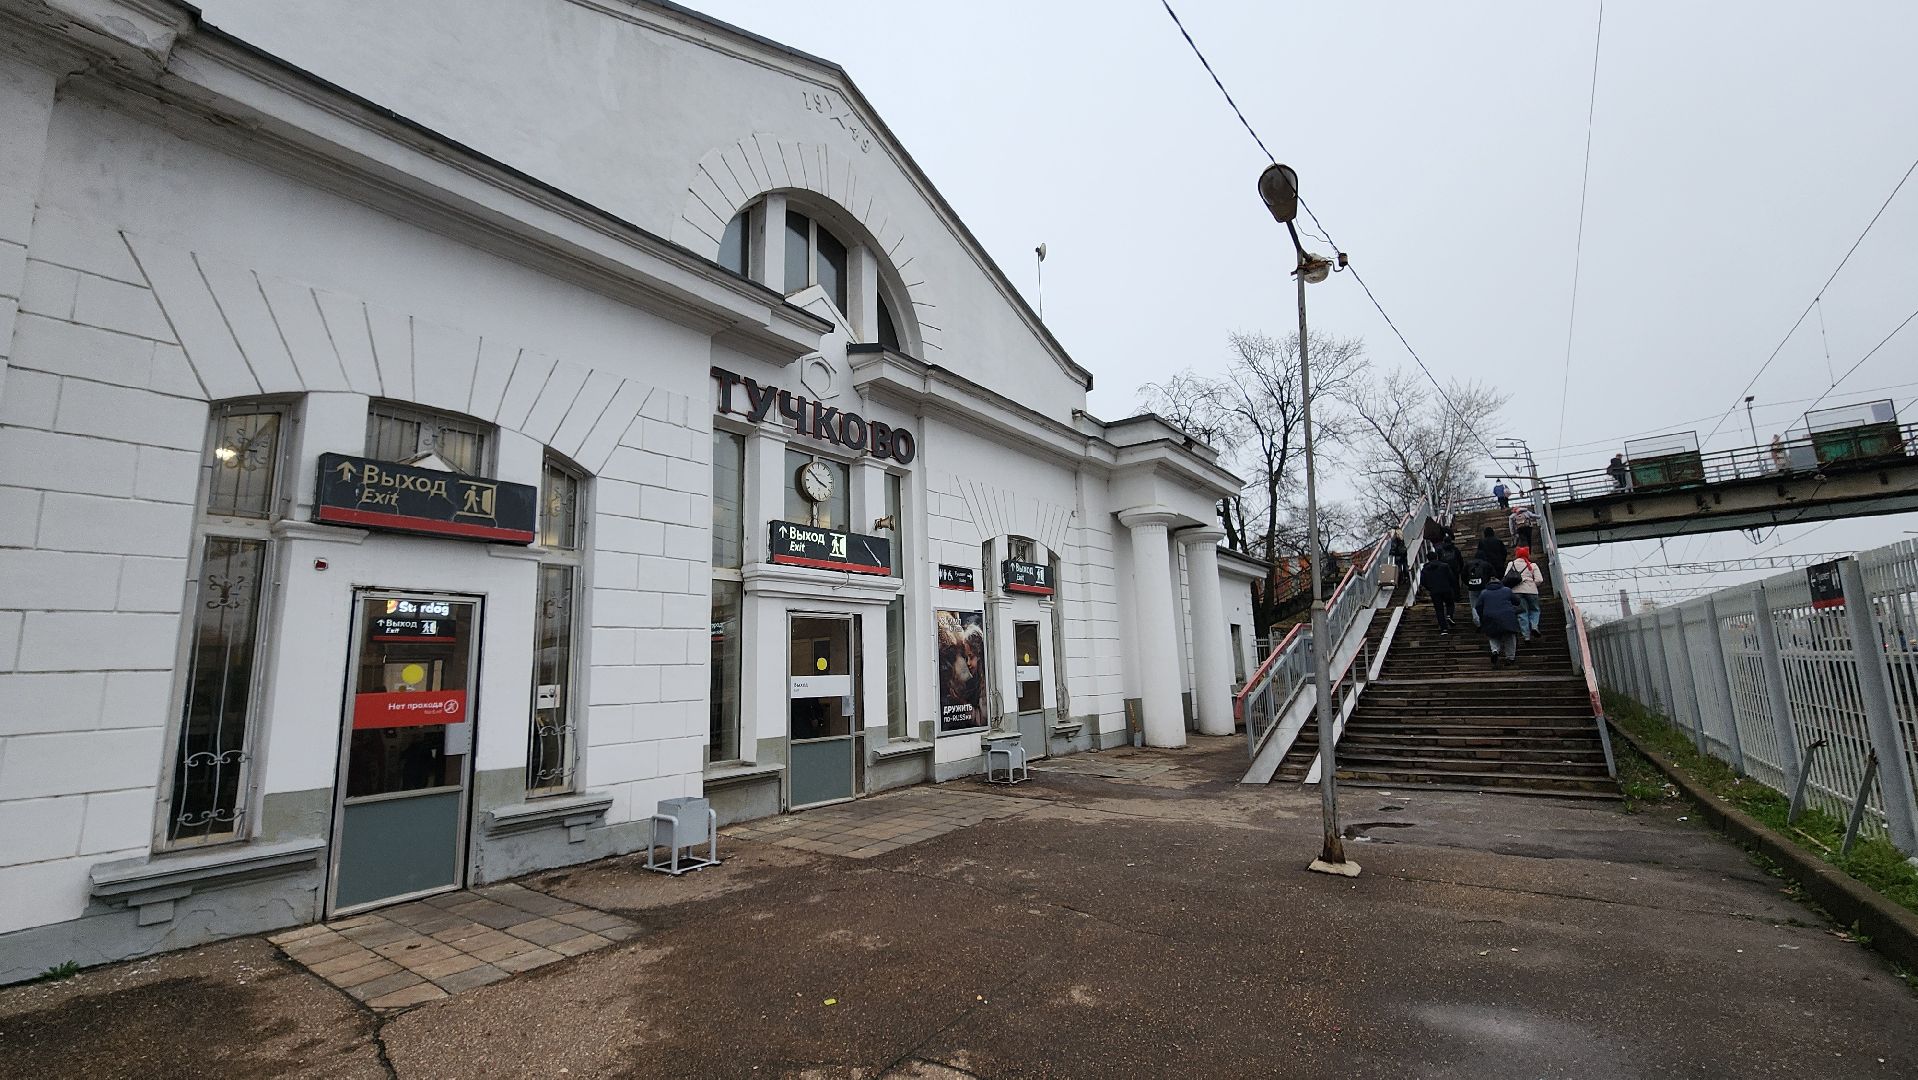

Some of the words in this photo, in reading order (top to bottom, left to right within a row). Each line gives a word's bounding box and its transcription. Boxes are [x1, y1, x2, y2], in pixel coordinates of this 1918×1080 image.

[710, 365, 916, 465] ТУЧКОВО
[362, 463, 447, 498] Выход
[361, 488, 400, 507] Exit
[789, 526, 826, 546] Выход
[789, 540, 806, 553] Exit
[385, 619, 418, 629] Выход
[388, 703, 405, 711] Нет
[943, 703, 973, 715] ДРУЖИТЬ
